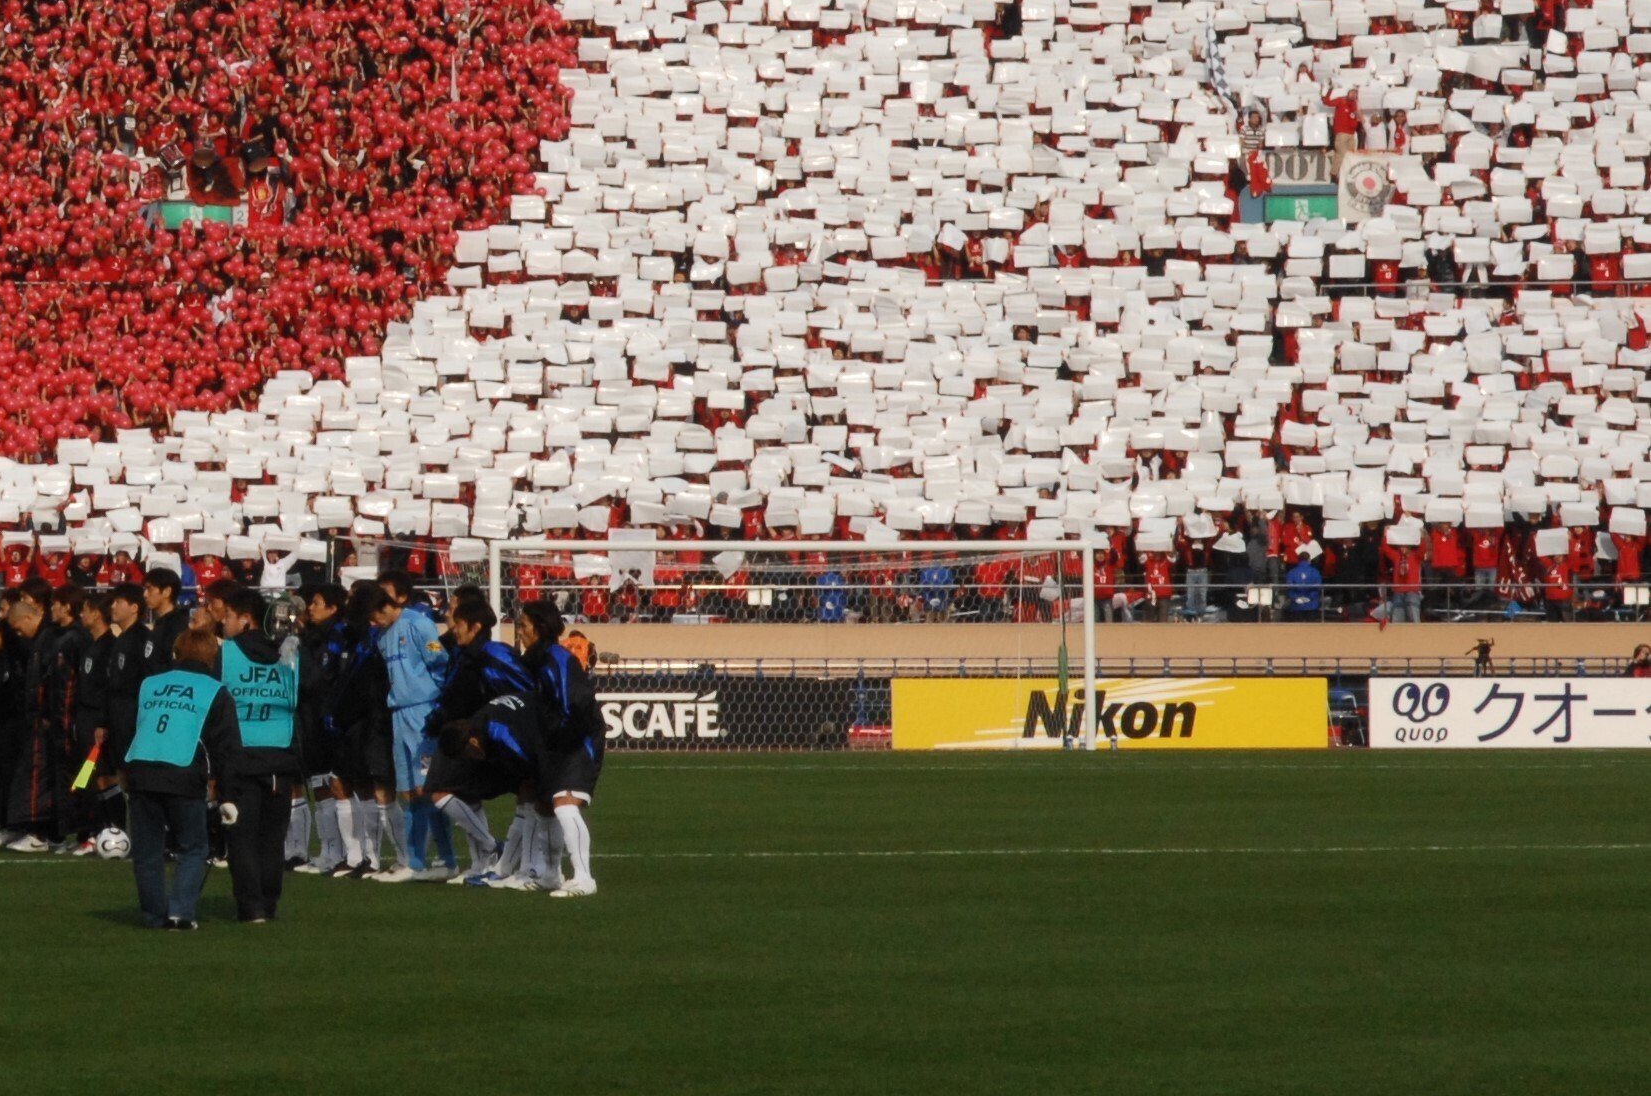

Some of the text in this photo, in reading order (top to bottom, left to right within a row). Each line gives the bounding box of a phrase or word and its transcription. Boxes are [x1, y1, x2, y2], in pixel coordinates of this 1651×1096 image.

[240, 667, 280, 683] JFA
[153, 684, 194, 700] JFA
[231, 687, 289, 699] OFFICIAL
[143, 700, 197, 714] OFFICIAL
[245, 703, 271, 721] 10
[600, 691, 720, 738] SCAFÉ
[1022, 688, 1197, 739] Nikon
[1474, 682, 1651, 743] クオー
[156, 714, 169, 734] 6
